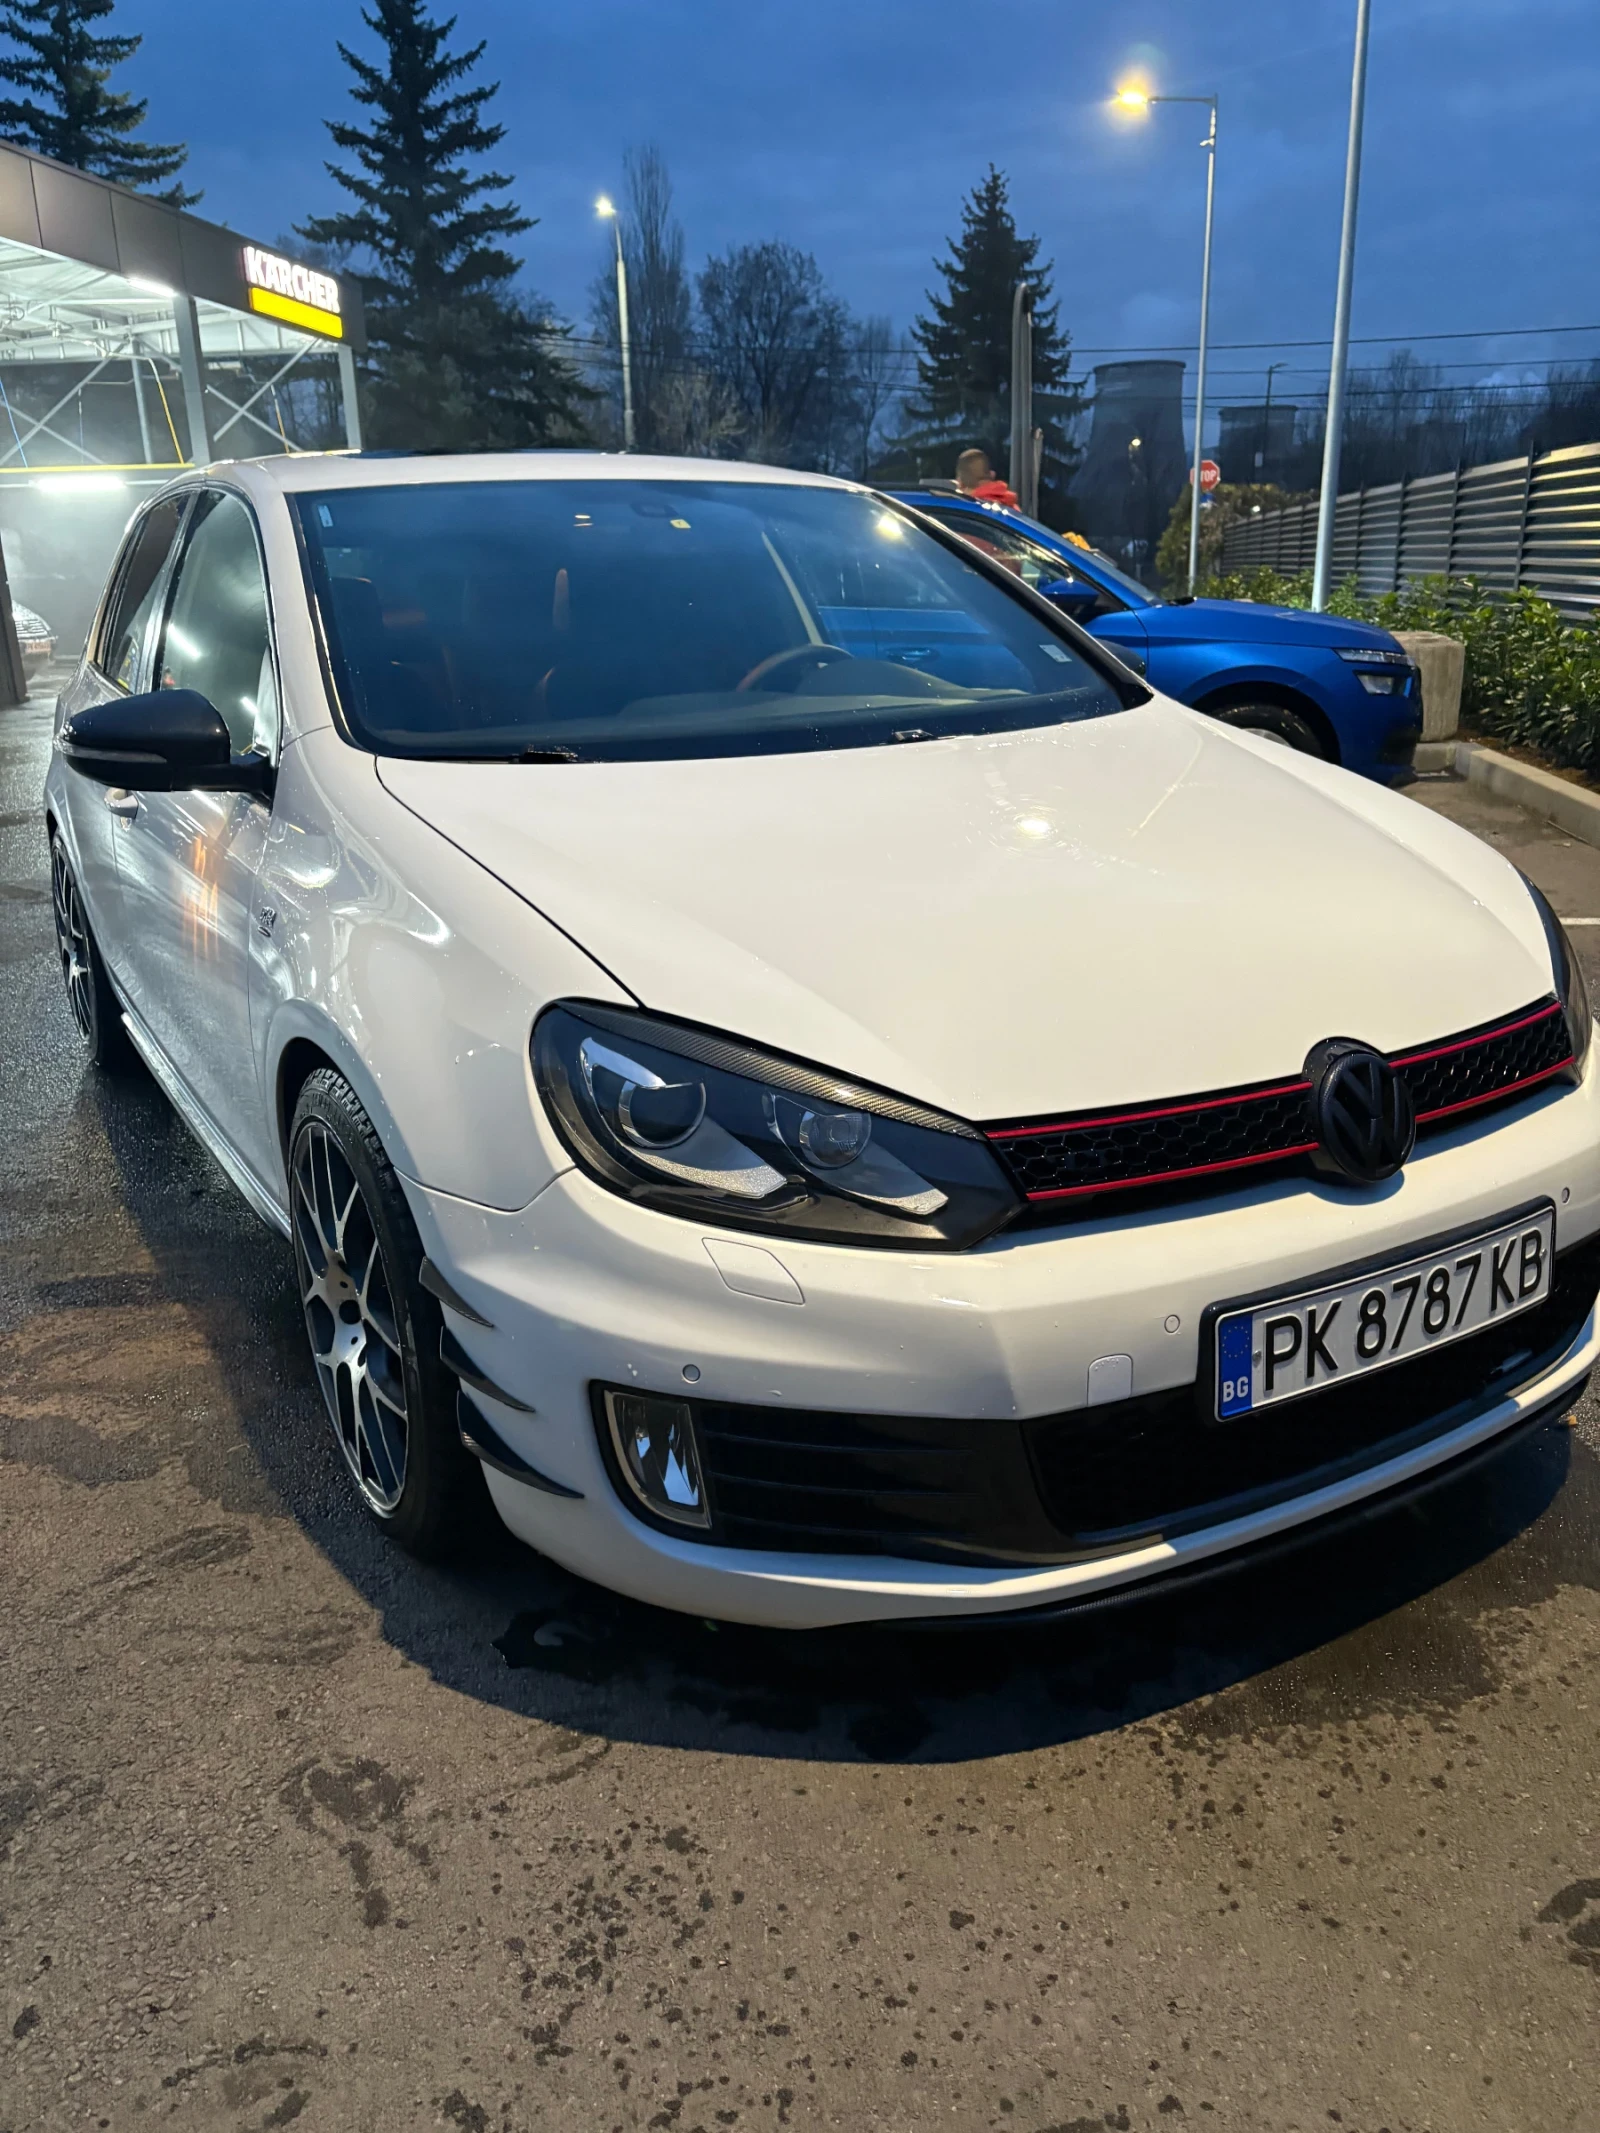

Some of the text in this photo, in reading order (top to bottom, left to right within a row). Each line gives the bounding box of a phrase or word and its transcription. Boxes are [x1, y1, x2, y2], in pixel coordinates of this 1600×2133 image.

[1263, 1229, 1543, 1391] PK 8787 KB
[1222, 1375, 1249, 1403] BG
